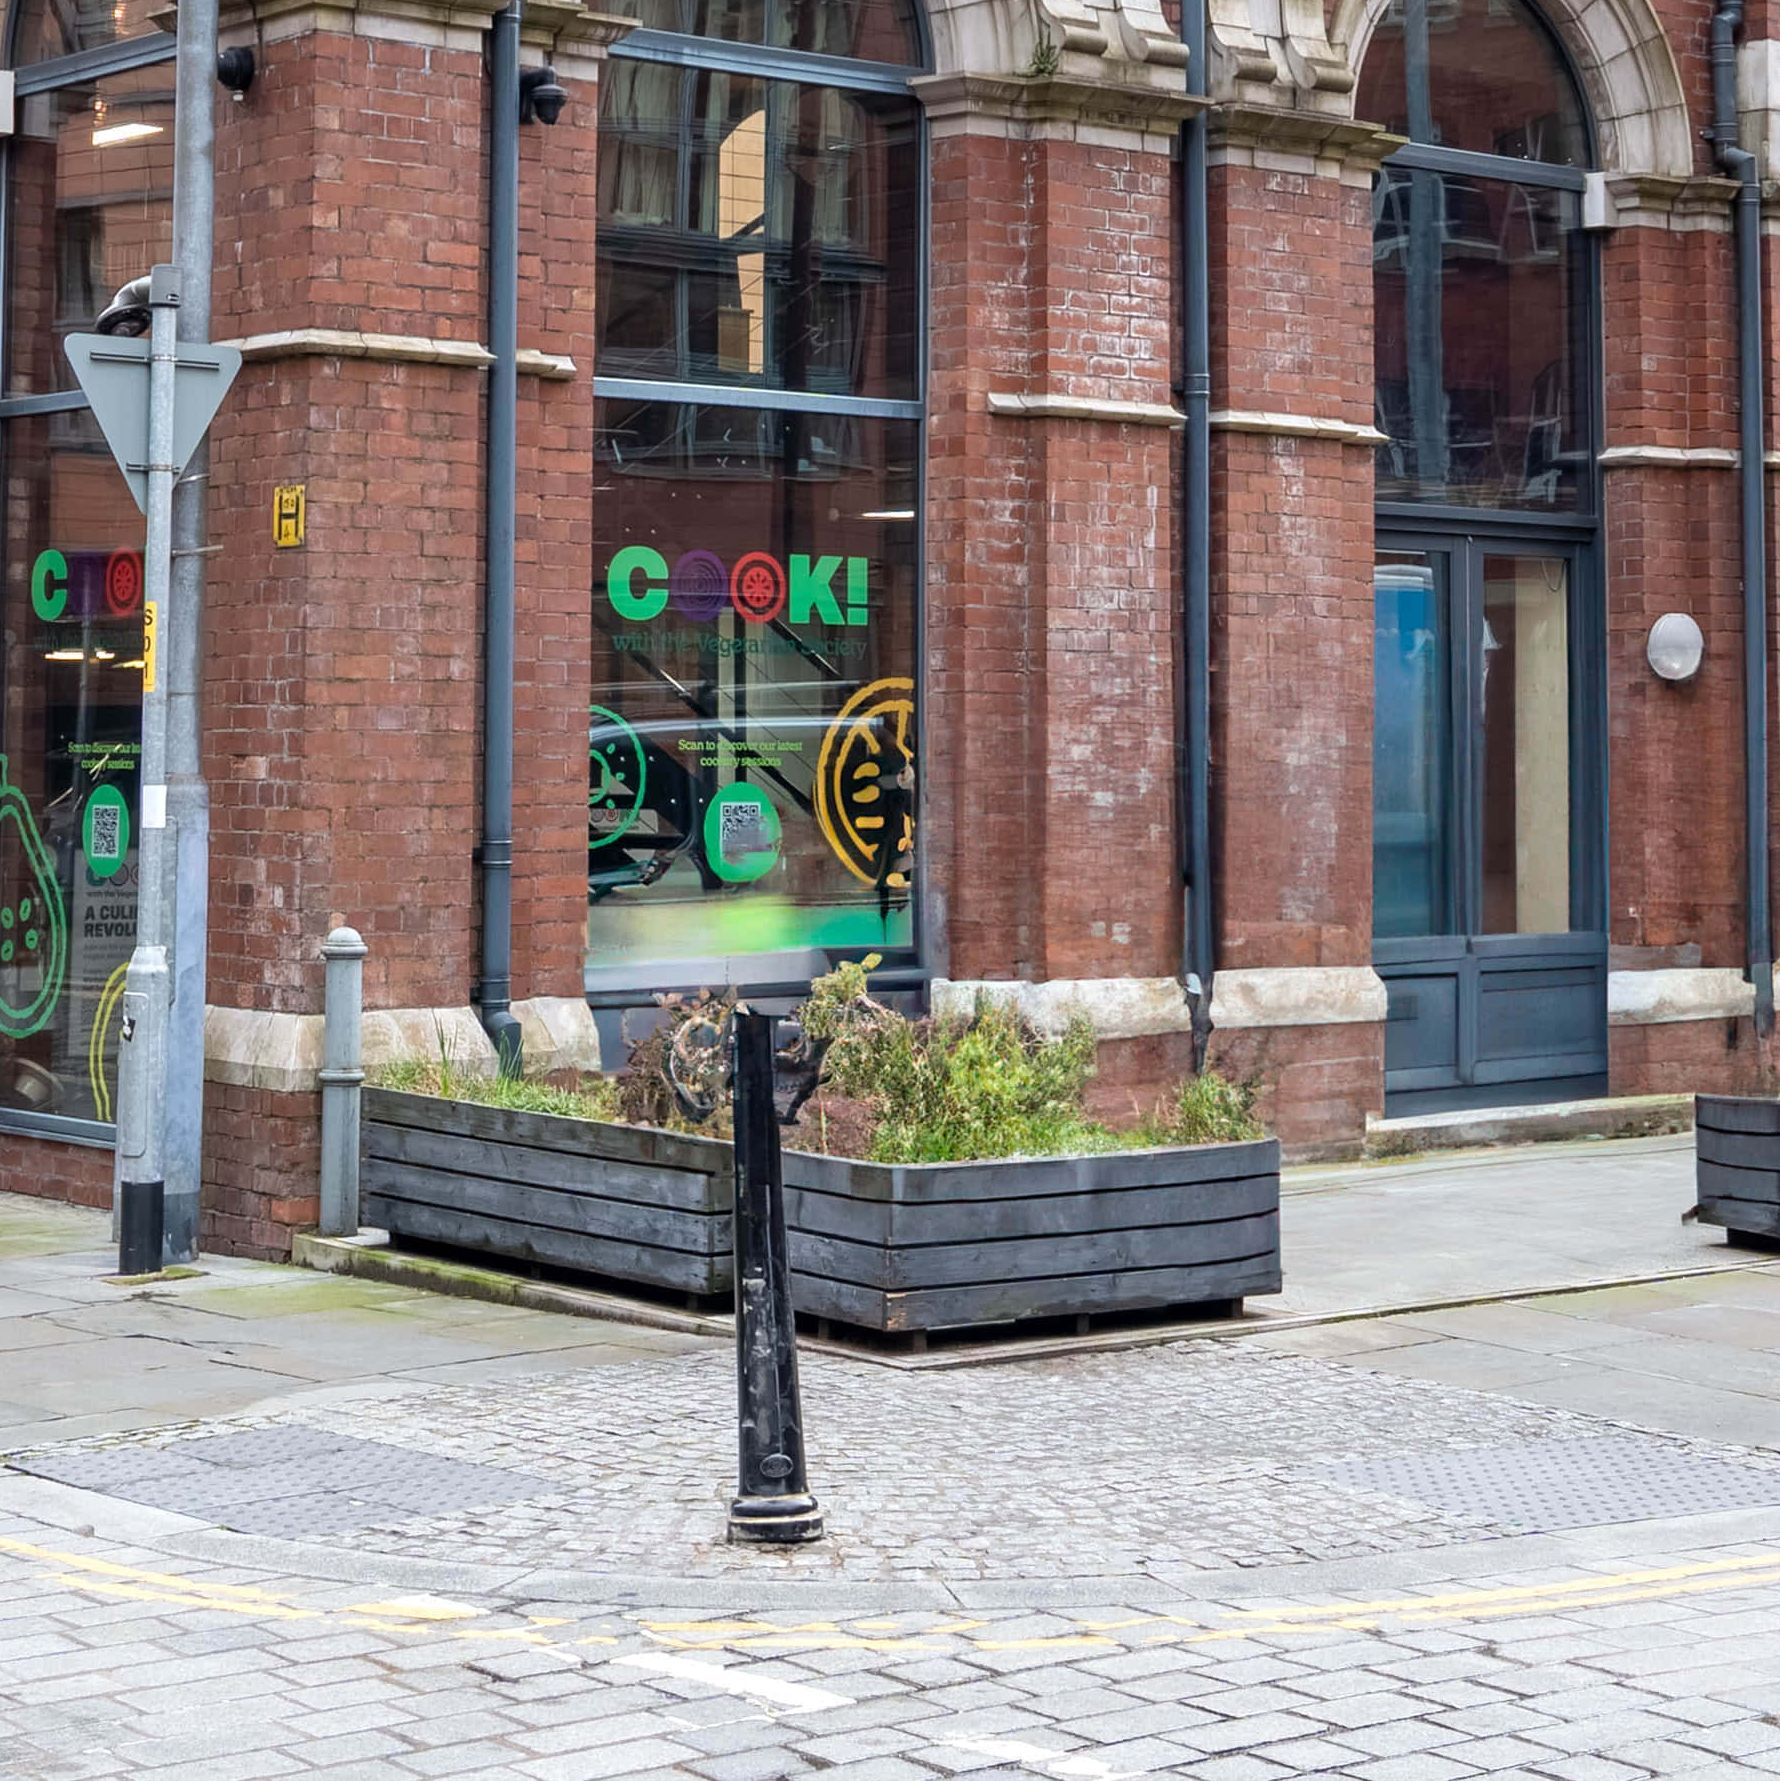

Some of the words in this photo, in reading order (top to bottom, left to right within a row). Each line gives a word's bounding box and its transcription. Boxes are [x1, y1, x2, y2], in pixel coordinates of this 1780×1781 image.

[607, 545, 869, 626] COOK!
[678, 739, 704, 751] Scan
[84, 905, 95, 921] A
